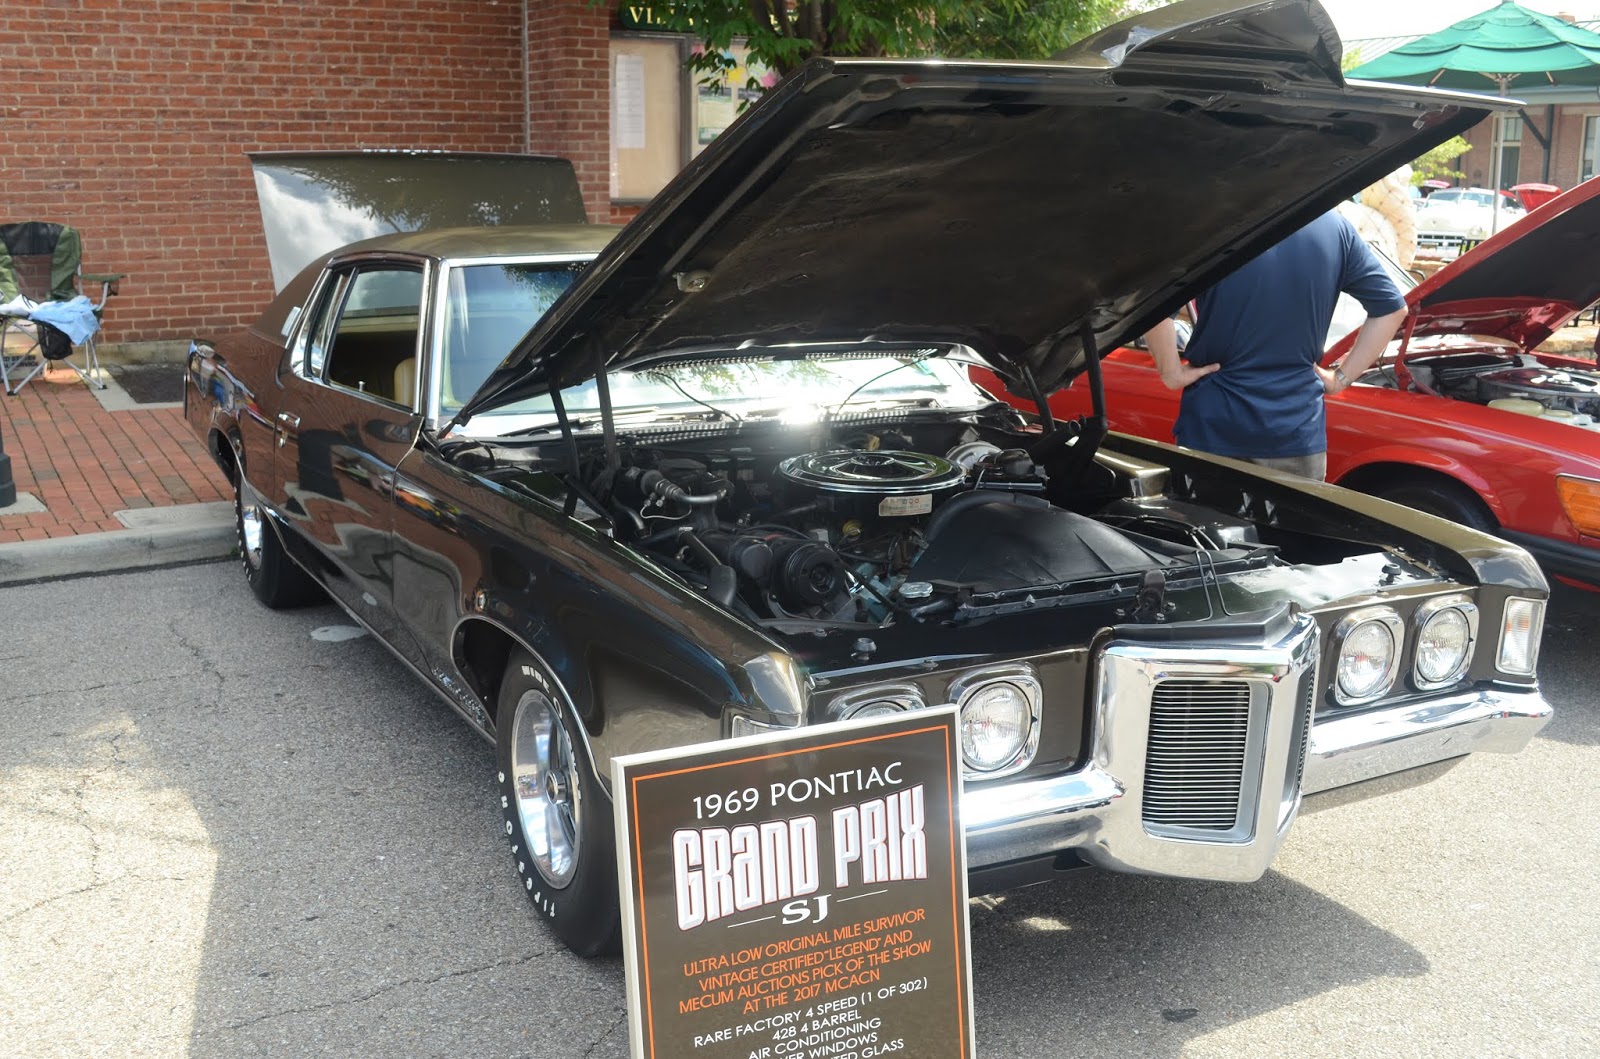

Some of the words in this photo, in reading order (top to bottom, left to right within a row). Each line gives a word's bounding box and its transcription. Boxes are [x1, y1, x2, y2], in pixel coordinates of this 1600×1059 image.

[693, 787, 760, 819] 1969
[770, 762, 903, 806] PONTIAC
[832, 783, 928, 889] PRIX
[781, 894, 832, 925] SJ
[683, 955, 729, 977] ULTRA
[731, 946, 764, 966] LOW
[765, 934, 832, 957] ORIGINAL
[834, 923, 862, 942] MILE
[863, 908, 926, 934] SURVIVOR
[699, 969, 759, 992] VINTAGE
[883, 929, 913, 948] AND
[679, 989, 734, 1014] MECUM
[737, 972, 810, 1000] AUCTIONS
[812, 963, 844, 983] PICK
[846, 956, 865, 973] OF
[867, 949, 891, 967] THE
[893, 939, 932, 961] SHOW
[742, 999, 764, 1015] AT
[763, 993, 788, 1010] THE
[794, 983, 821, 1002] 2017
[825, 968, 881, 993] MCACN
[694, 1031, 732, 1048] RARE
[736, 1010, 802, 1037] FACTORY
[805, 1007, 815, 1018] 4
[817, 996, 859, 1016] SPEED
[861, 991, 872, 1007] (1
[877, 986, 897, 999] OF
[899, 976, 929, 994] 302)
[748, 1046, 771, 1059] AIR
[774, 1017, 882, 1055] CONDITIONING
[772, 1026, 797, 1041] 428
[800, 1023, 810, 1034] 4
[812, 1009, 862, 1030] BARREL
[808, 1032, 878, 1058] WINDOWS
[861, 1038, 905, 1058] GLASS
